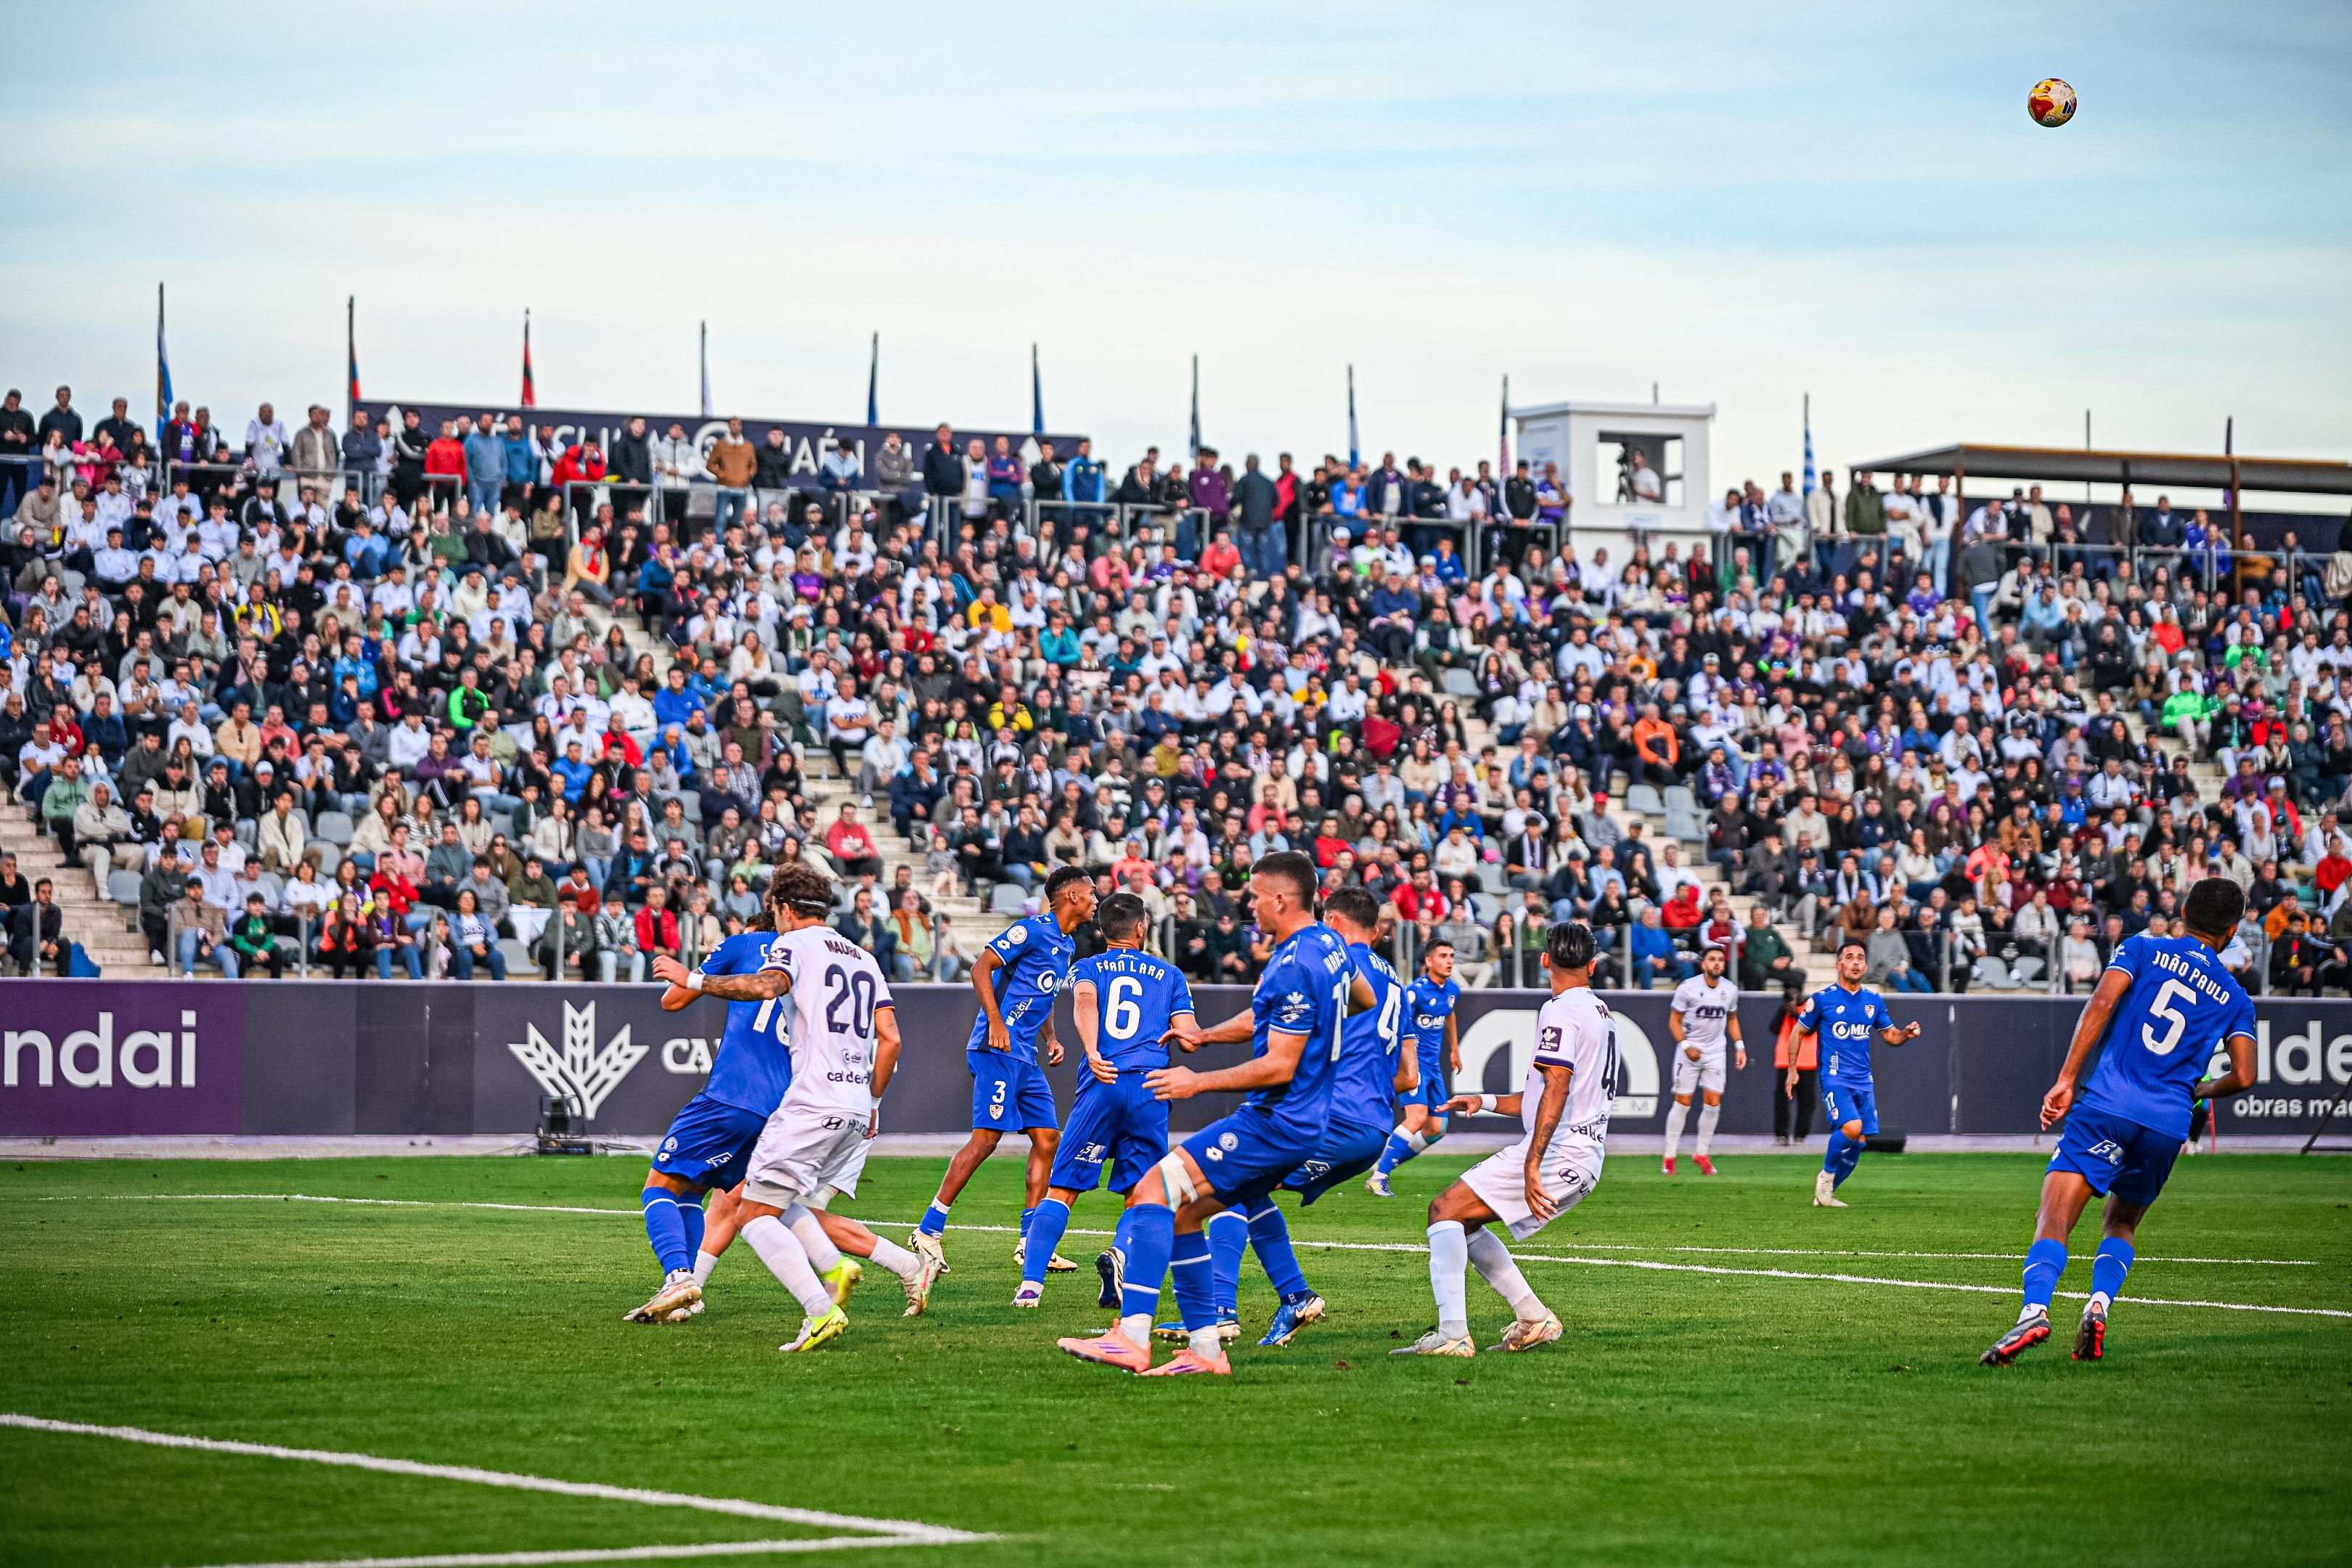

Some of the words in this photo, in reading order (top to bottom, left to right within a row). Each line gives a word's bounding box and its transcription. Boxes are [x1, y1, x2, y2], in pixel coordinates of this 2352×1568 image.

[824, 939, 862, 960] MAURO
[1130, 960, 1165, 981] LARA
[2152, 950, 2189, 977] JOÃO
[2188, 967, 2230, 1005] PAULO
[825, 963, 876, 1040] 20
[1105, 976, 1143, 1040] 6
[1377, 981, 1401, 1055] 4
[2141, 978, 2197, 1055] 5
[3, 1009, 196, 1088] ndai
[1601, 1030, 1616, 1101] 4
[1677, 1063, 1683, 1077] 7
[992, 1080, 1006, 1103] 3
[2234, 1095, 2303, 1117] obras
[2308, 1098, 2352, 1118] ma
